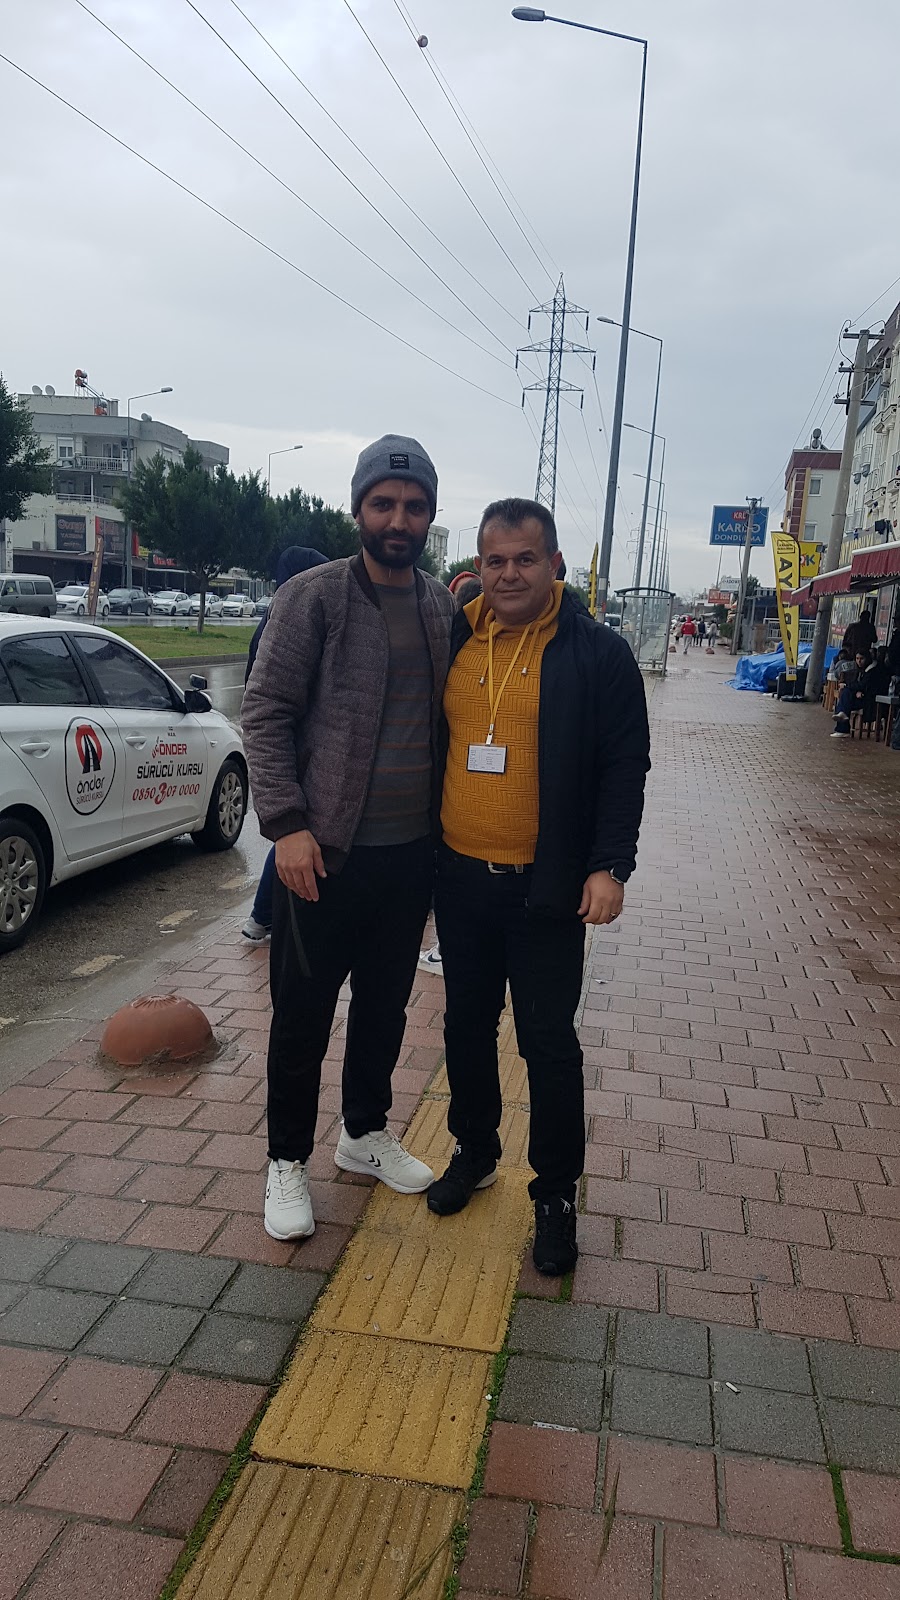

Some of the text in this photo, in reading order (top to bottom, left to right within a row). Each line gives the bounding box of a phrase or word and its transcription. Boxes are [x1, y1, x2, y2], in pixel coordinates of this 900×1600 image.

[159, 740, 187, 756] ÖNDER
[136, 761, 204, 779] SÜRÜCÜ KURSU
[132, 787, 156, 801] 0850
[179, 783, 200, 796] 0000
